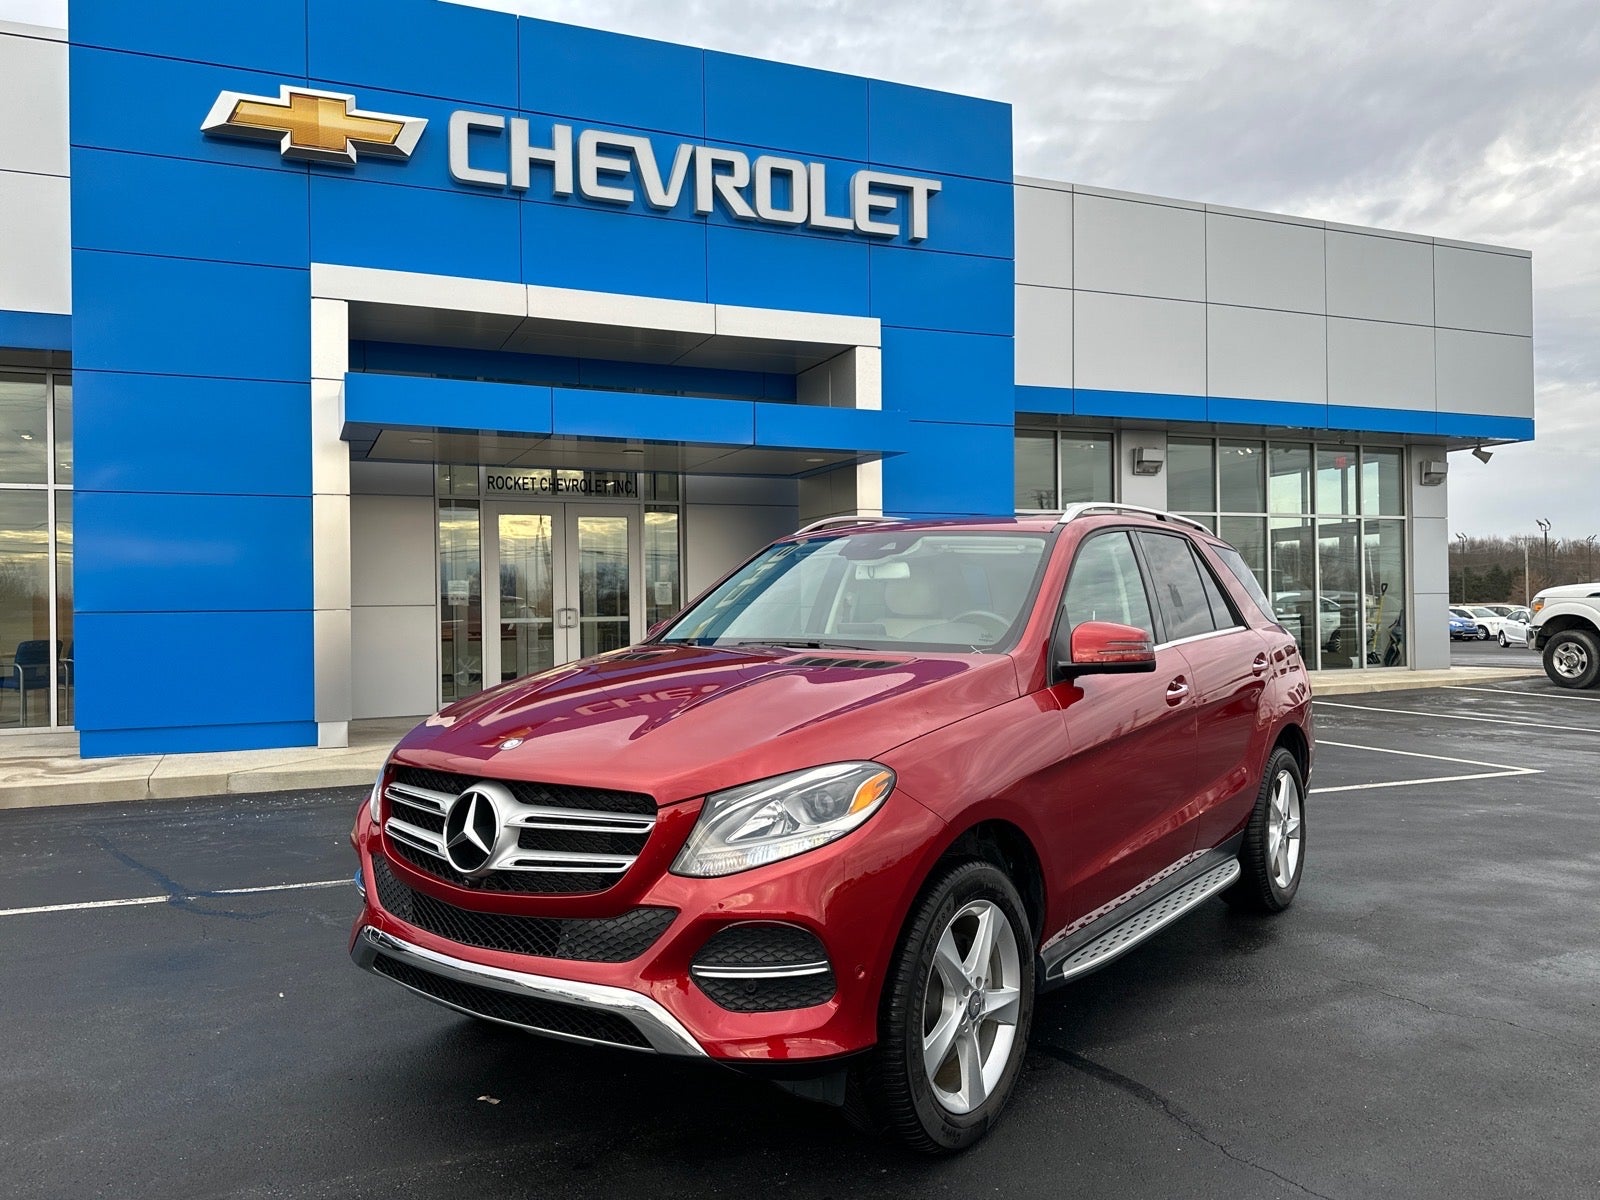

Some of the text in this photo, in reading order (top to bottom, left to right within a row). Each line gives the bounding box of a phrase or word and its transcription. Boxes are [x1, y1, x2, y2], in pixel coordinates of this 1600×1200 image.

[448, 110, 942, 242] CHEVROLET
[487, 475, 536, 491] ROCKET
[613, 480, 635, 494] INC.
